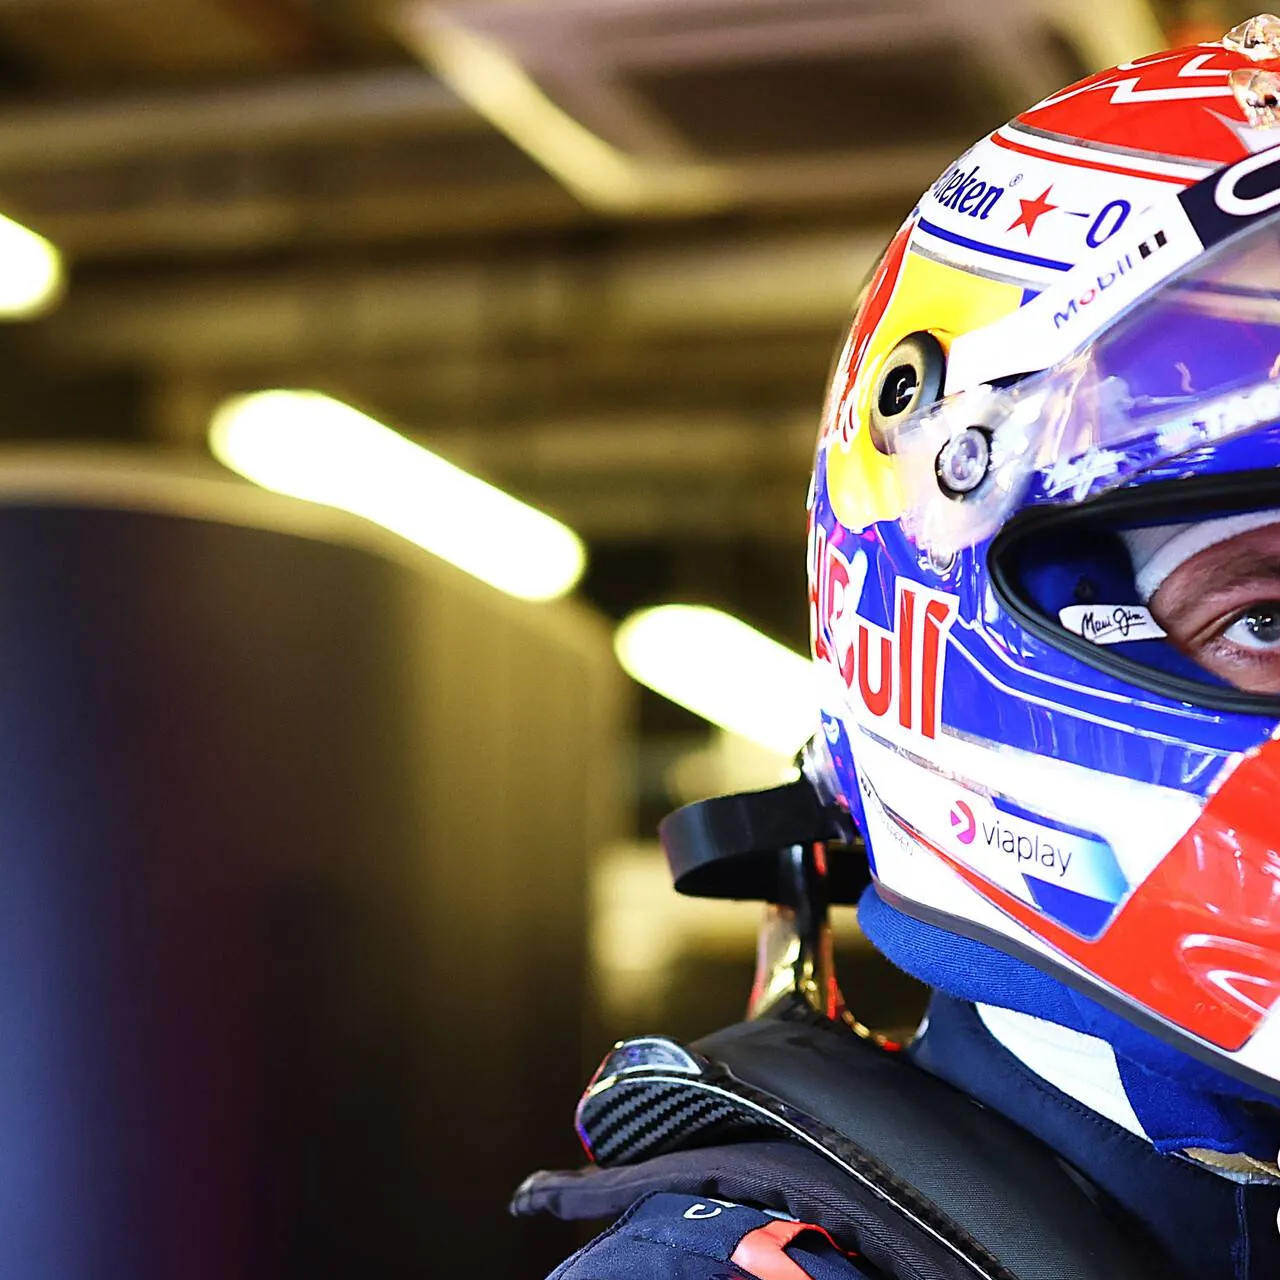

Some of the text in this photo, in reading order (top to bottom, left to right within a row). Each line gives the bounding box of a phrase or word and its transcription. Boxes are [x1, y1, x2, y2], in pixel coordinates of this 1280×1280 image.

[1053, 254, 1133, 329] Mobil
[1081, 607, 1145, 637] Maui Jim
[982, 820, 1072, 877] viaplay
